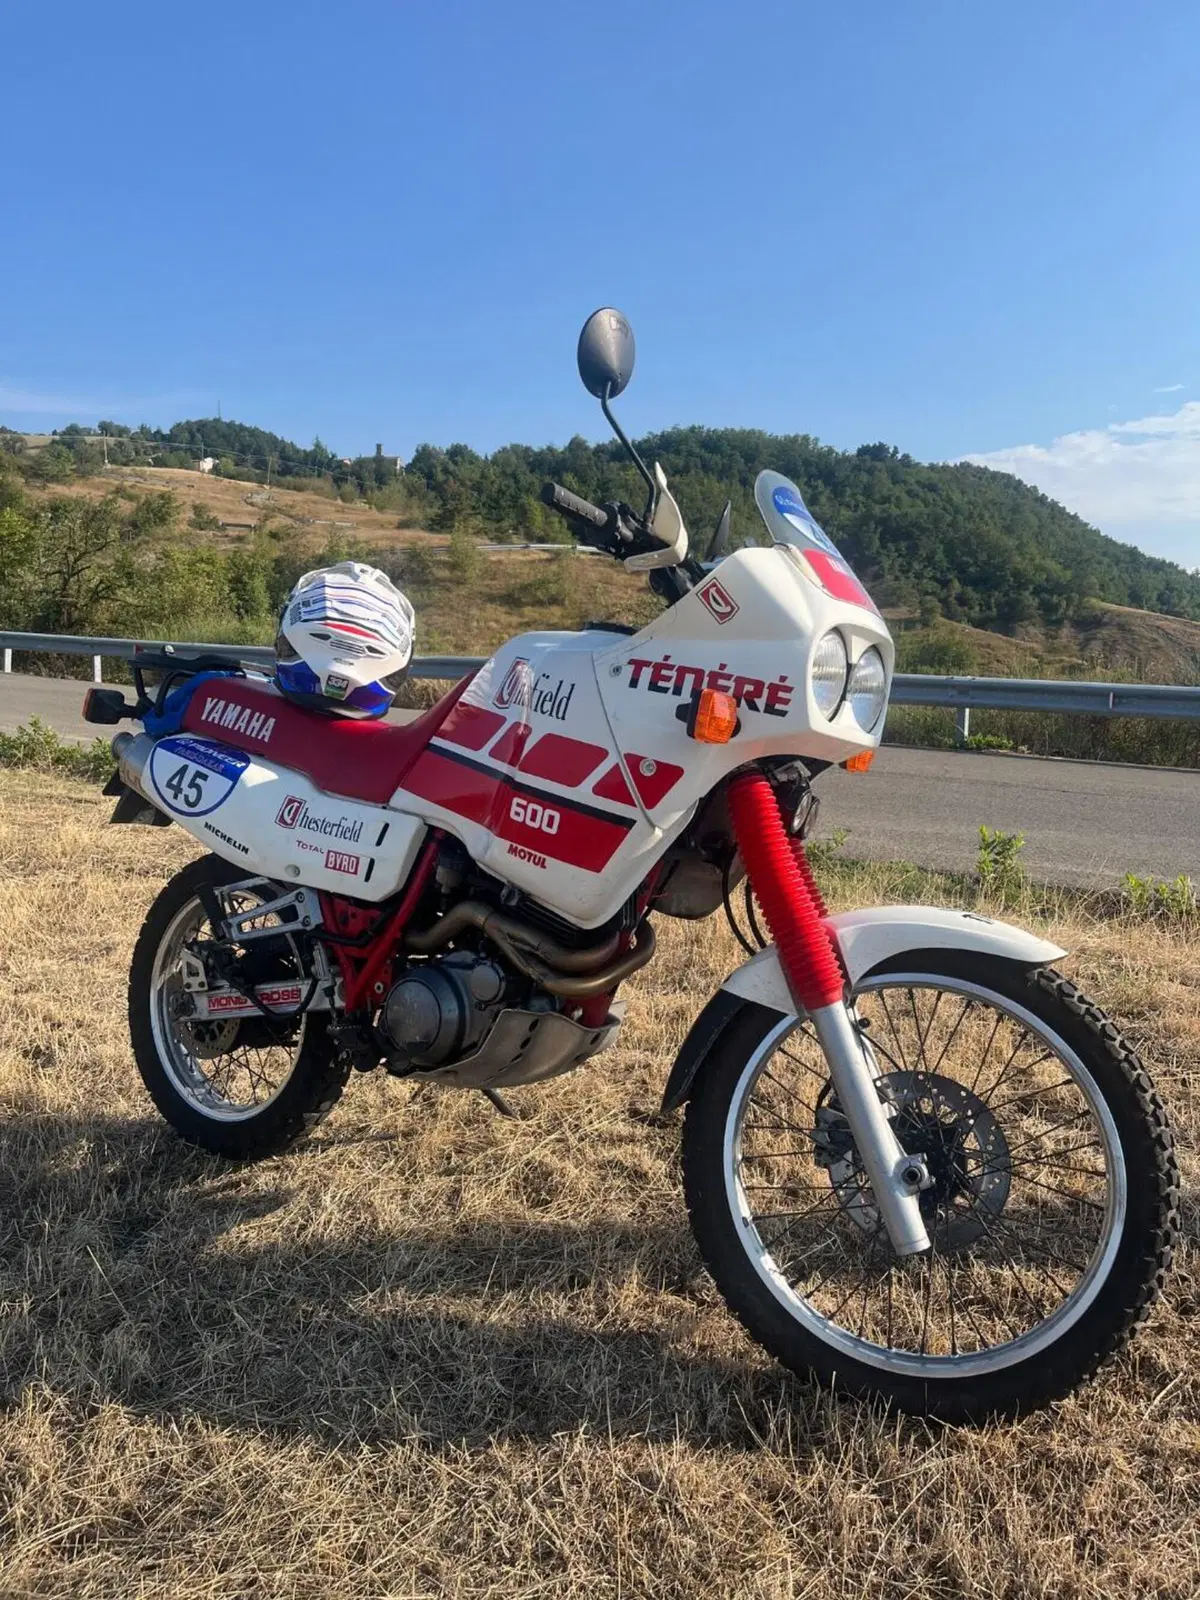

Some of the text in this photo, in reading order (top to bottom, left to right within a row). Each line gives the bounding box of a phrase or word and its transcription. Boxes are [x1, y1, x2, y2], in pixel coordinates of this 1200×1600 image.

[201, 697, 276, 743] YAMAHA
[165, 763, 209, 808] 45
[279, 799, 364, 843] Chesterfield
[509, 796, 561, 835] 600
[204, 821, 250, 855] MICHELIN
[296, 839, 324, 854] TOTAL
[507, 843, 547, 870] MOTUL
